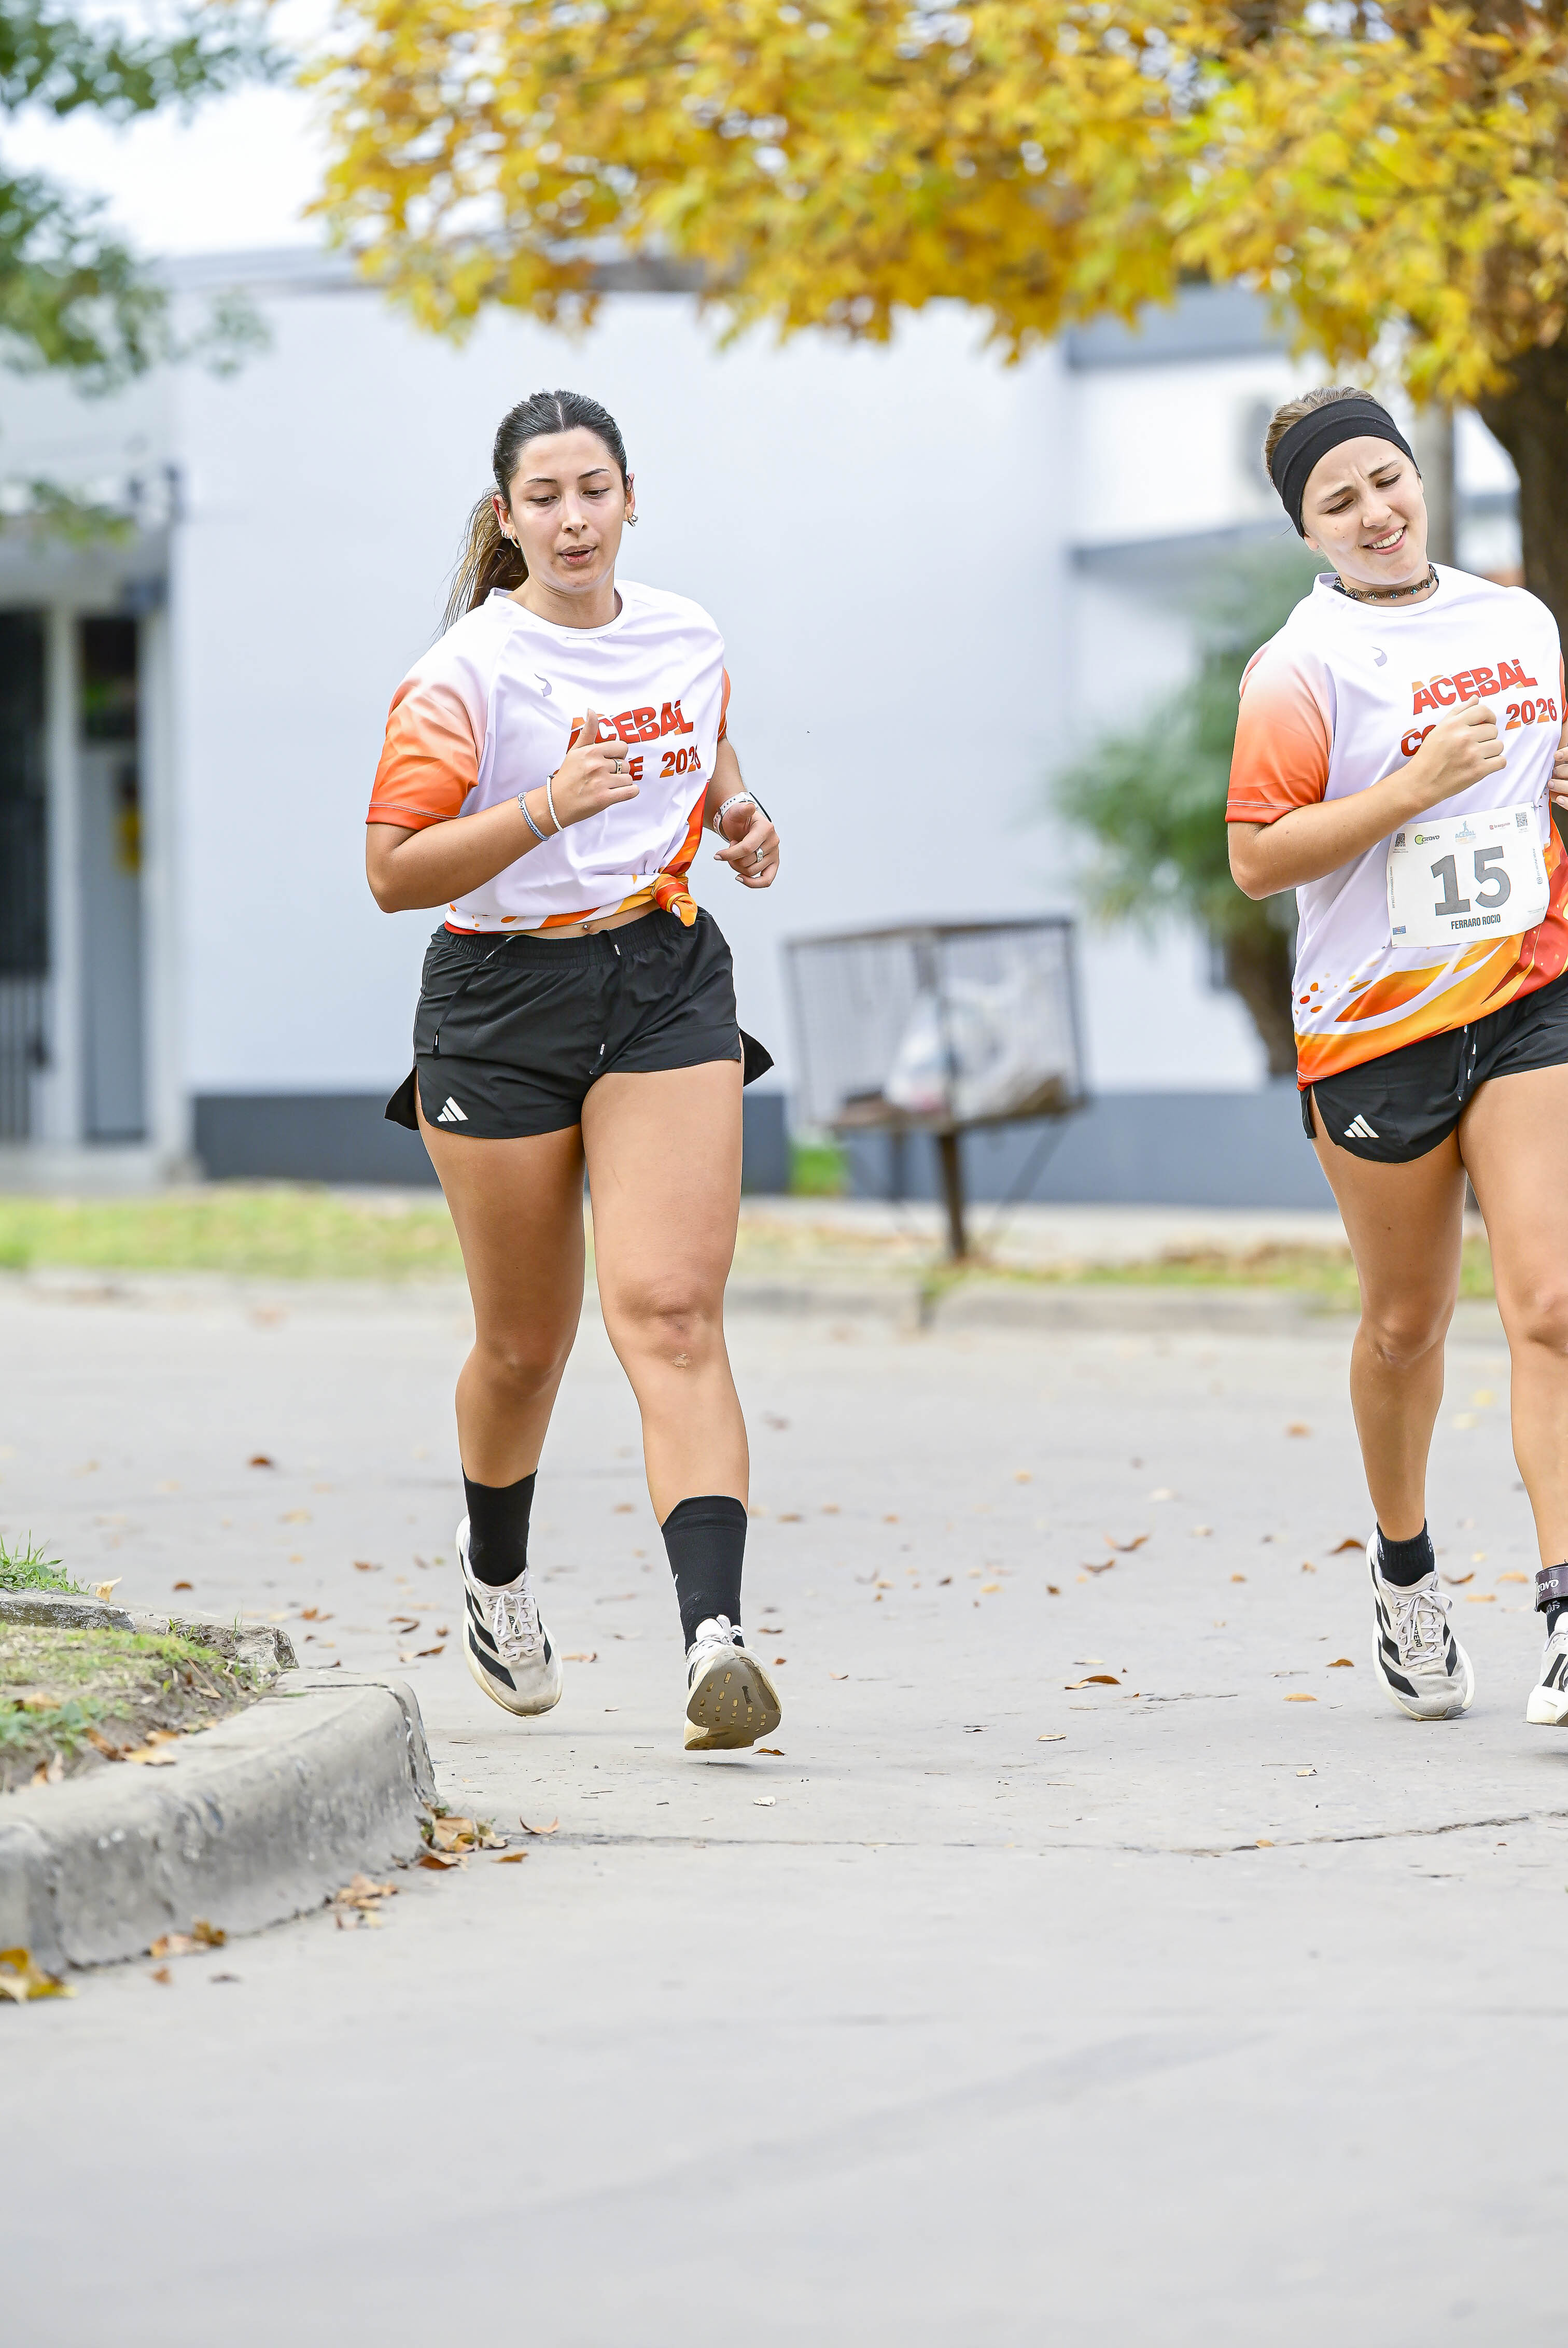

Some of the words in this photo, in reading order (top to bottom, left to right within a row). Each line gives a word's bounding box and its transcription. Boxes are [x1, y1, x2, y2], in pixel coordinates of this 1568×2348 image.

[1412, 659, 1537, 715] ACEBAL
[1505, 698, 1557, 731] 2026
[1431, 846, 1511, 916] 15
[1451, 917, 1481, 929] FERRARO
[1482, 914, 1501, 925] ROCIO
